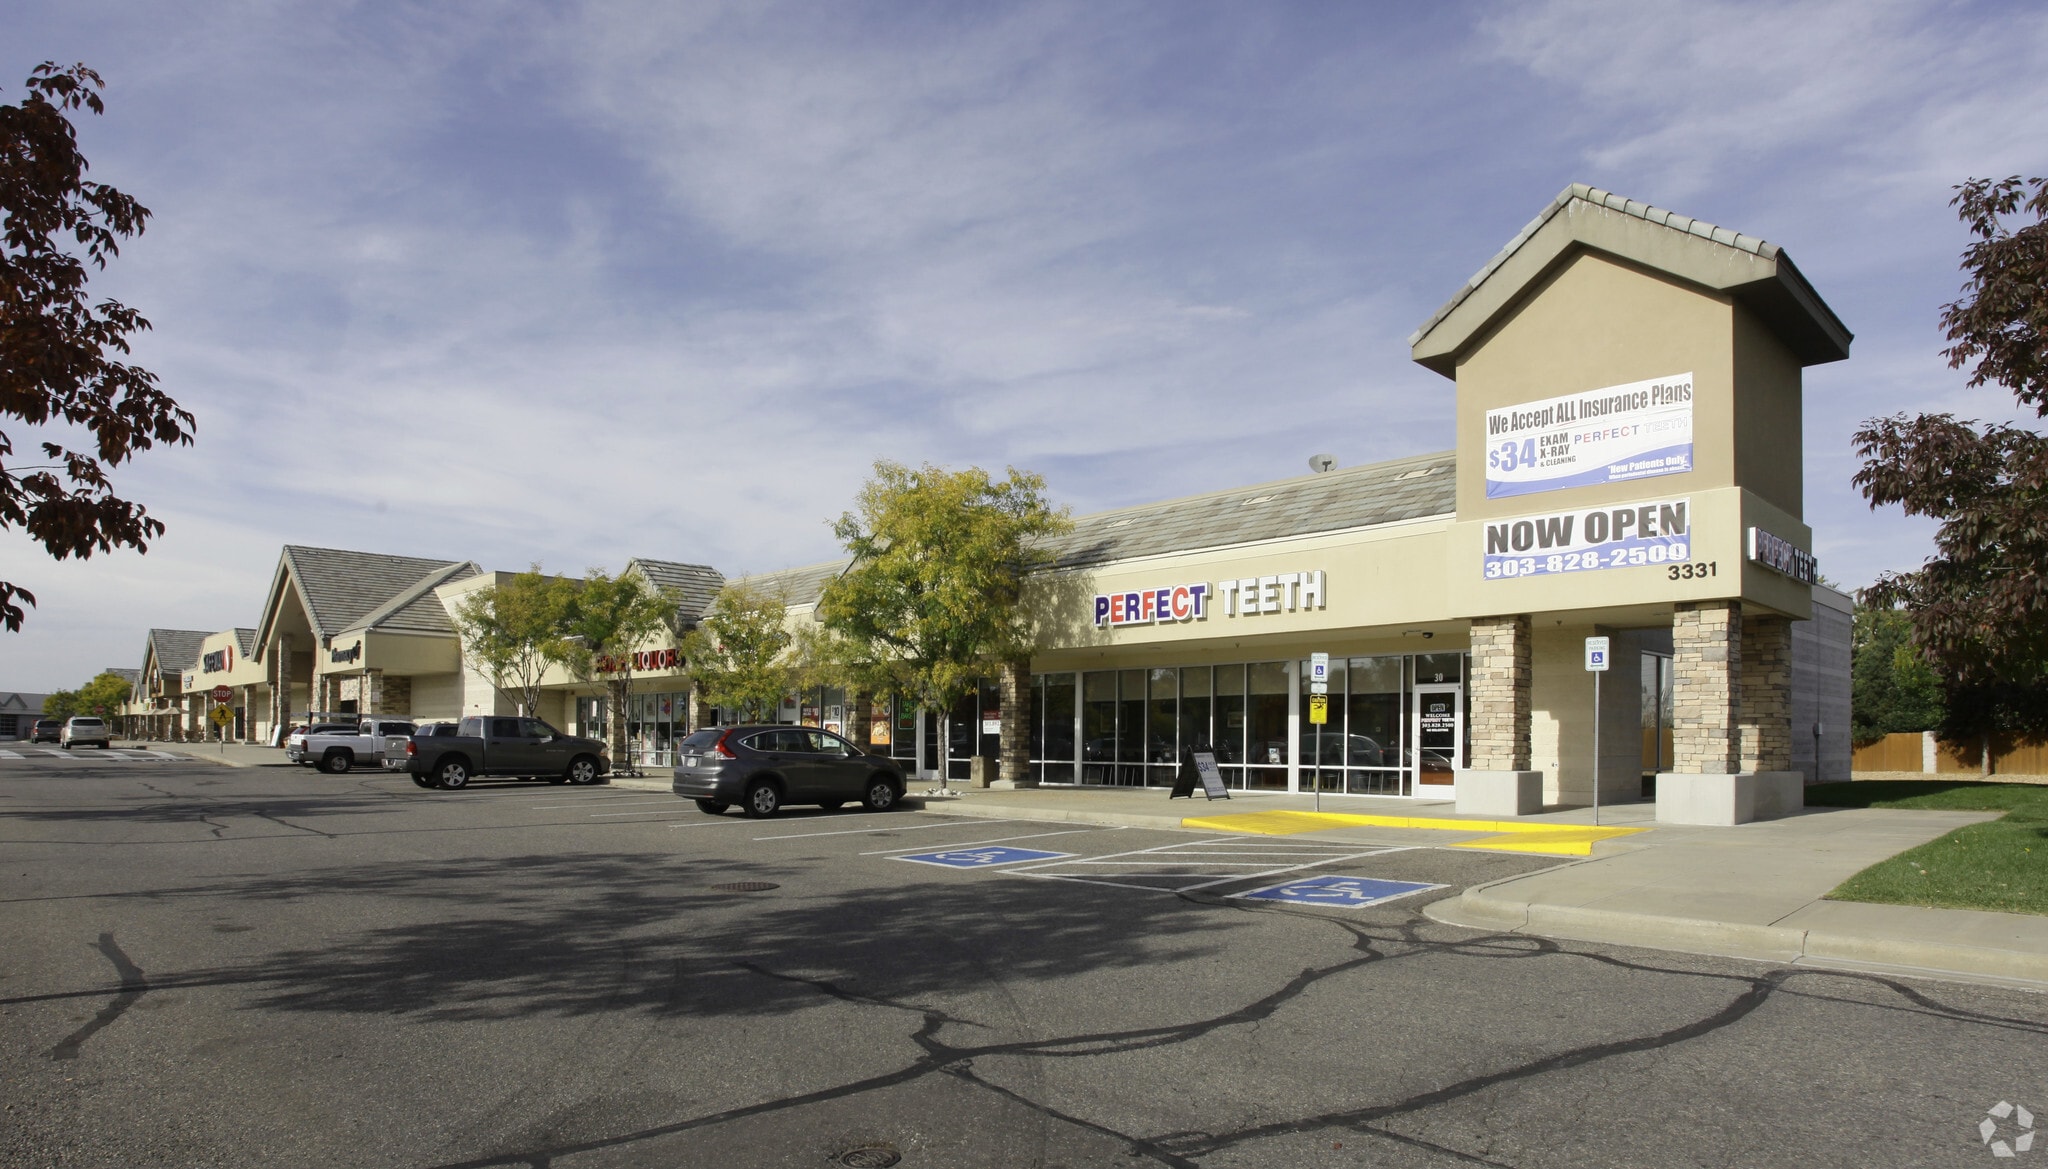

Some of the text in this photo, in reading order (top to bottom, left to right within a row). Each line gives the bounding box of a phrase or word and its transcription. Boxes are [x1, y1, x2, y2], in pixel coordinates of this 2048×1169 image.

[1489, 382, 1692, 435] We Accept ALL Insurance Plans
[1540, 432, 1569, 447] EXAM
[1574, 416, 1688, 444] PERFECT TEETH
[1489, 437, 1538, 472] $34
[1540, 444, 1570, 459] X-RAY
[1546, 455, 1577, 467] CLEANING
[1629, 459, 1665, 470] Patients
[1487, 502, 1686, 555] NOW OPEN
[1486, 543, 1687, 578] 303-828-2500
[1668, 561, 1717, 581] 3331
[1094, 570, 1325, 627] PERFECT TEETH
[1434, 673, 1443, 682] 30
[213, 690, 232, 698] STOP
